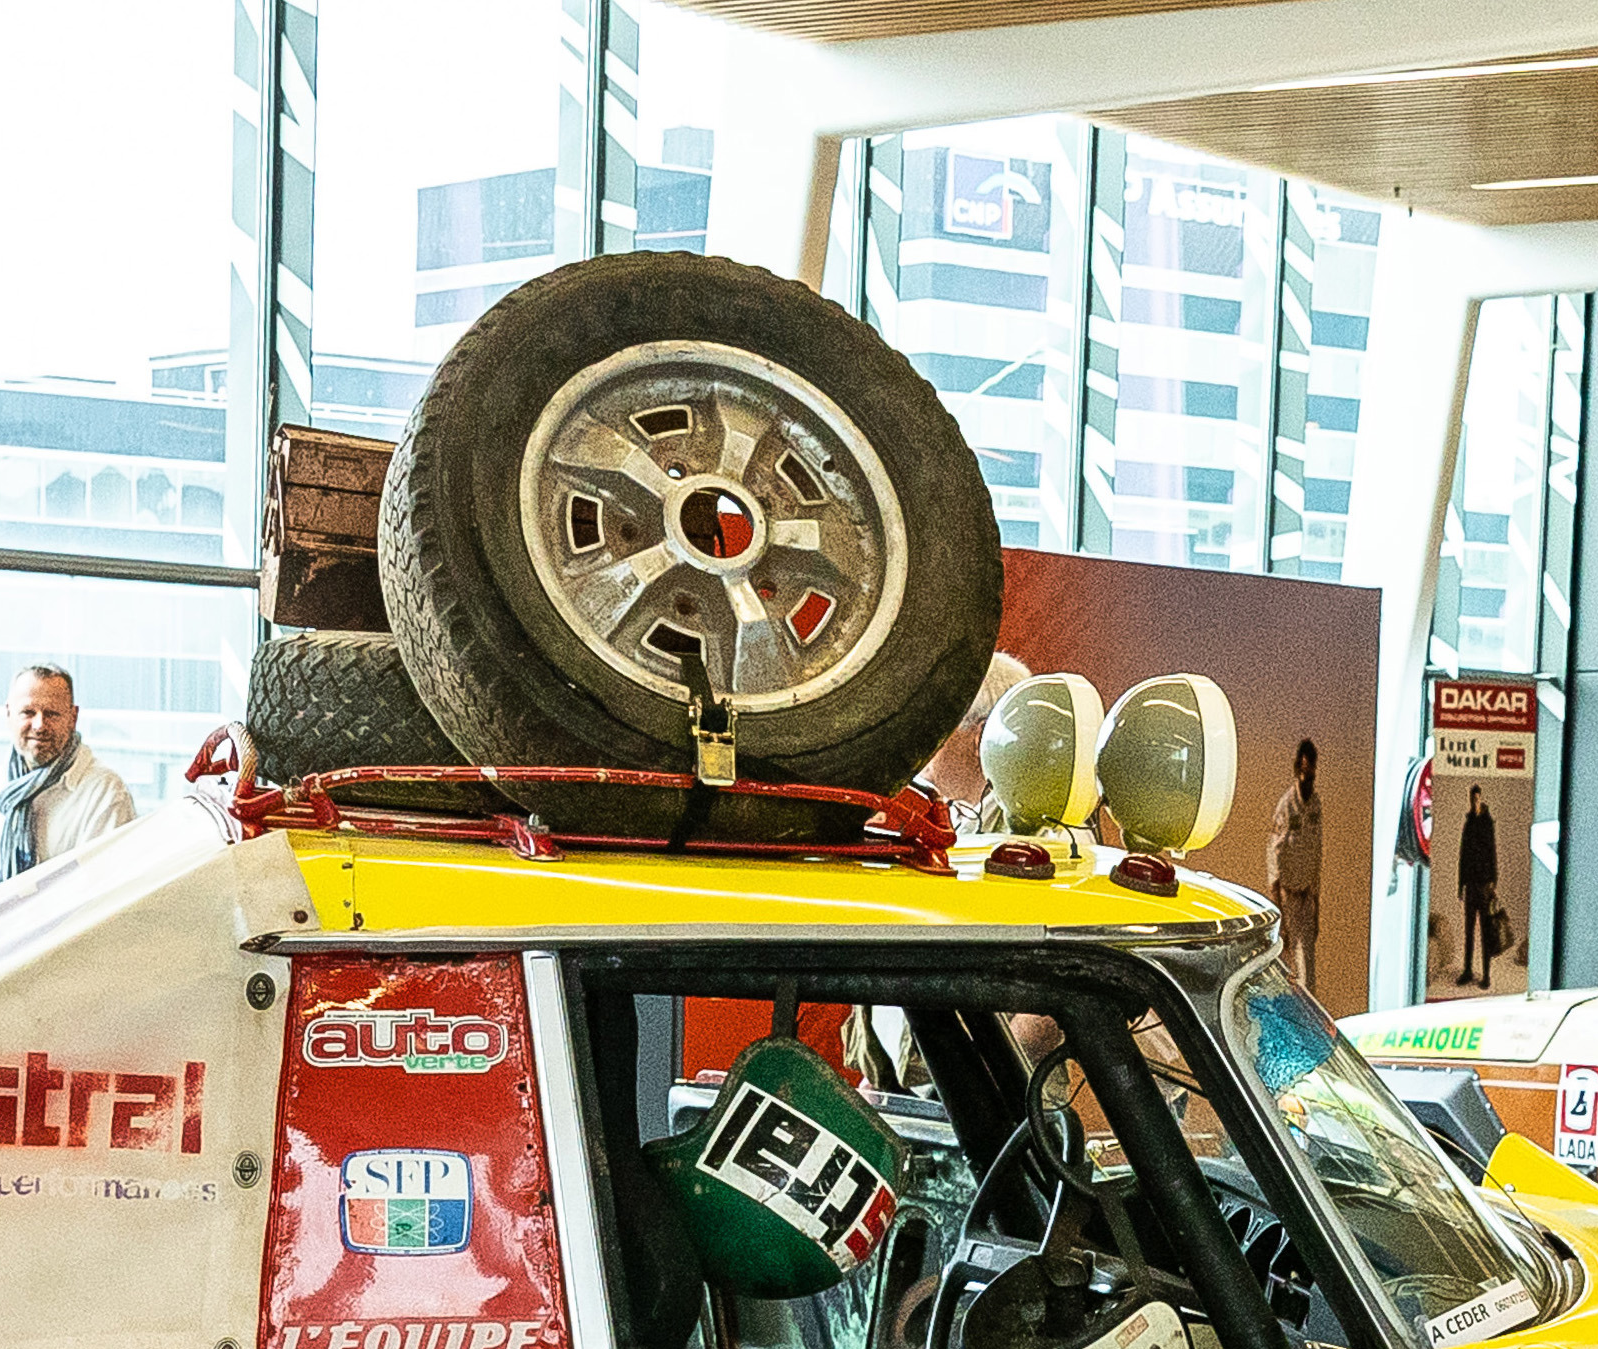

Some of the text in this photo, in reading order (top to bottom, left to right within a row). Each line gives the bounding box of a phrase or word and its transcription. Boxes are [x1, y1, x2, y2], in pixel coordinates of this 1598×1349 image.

[952, 197, 1002, 227] CNP
[1441, 687, 1528, 713] DAKAR
[311, 1016, 501, 1059] auto
[1381, 1026, 1484, 1051] AFRIQUE
[404, 1054, 488, 1070] verte
[1558, 1137, 1596, 1161] LADA
[366, 1159, 450, 1194] SFP
[1431, 1302, 1491, 1344] A CEDER
